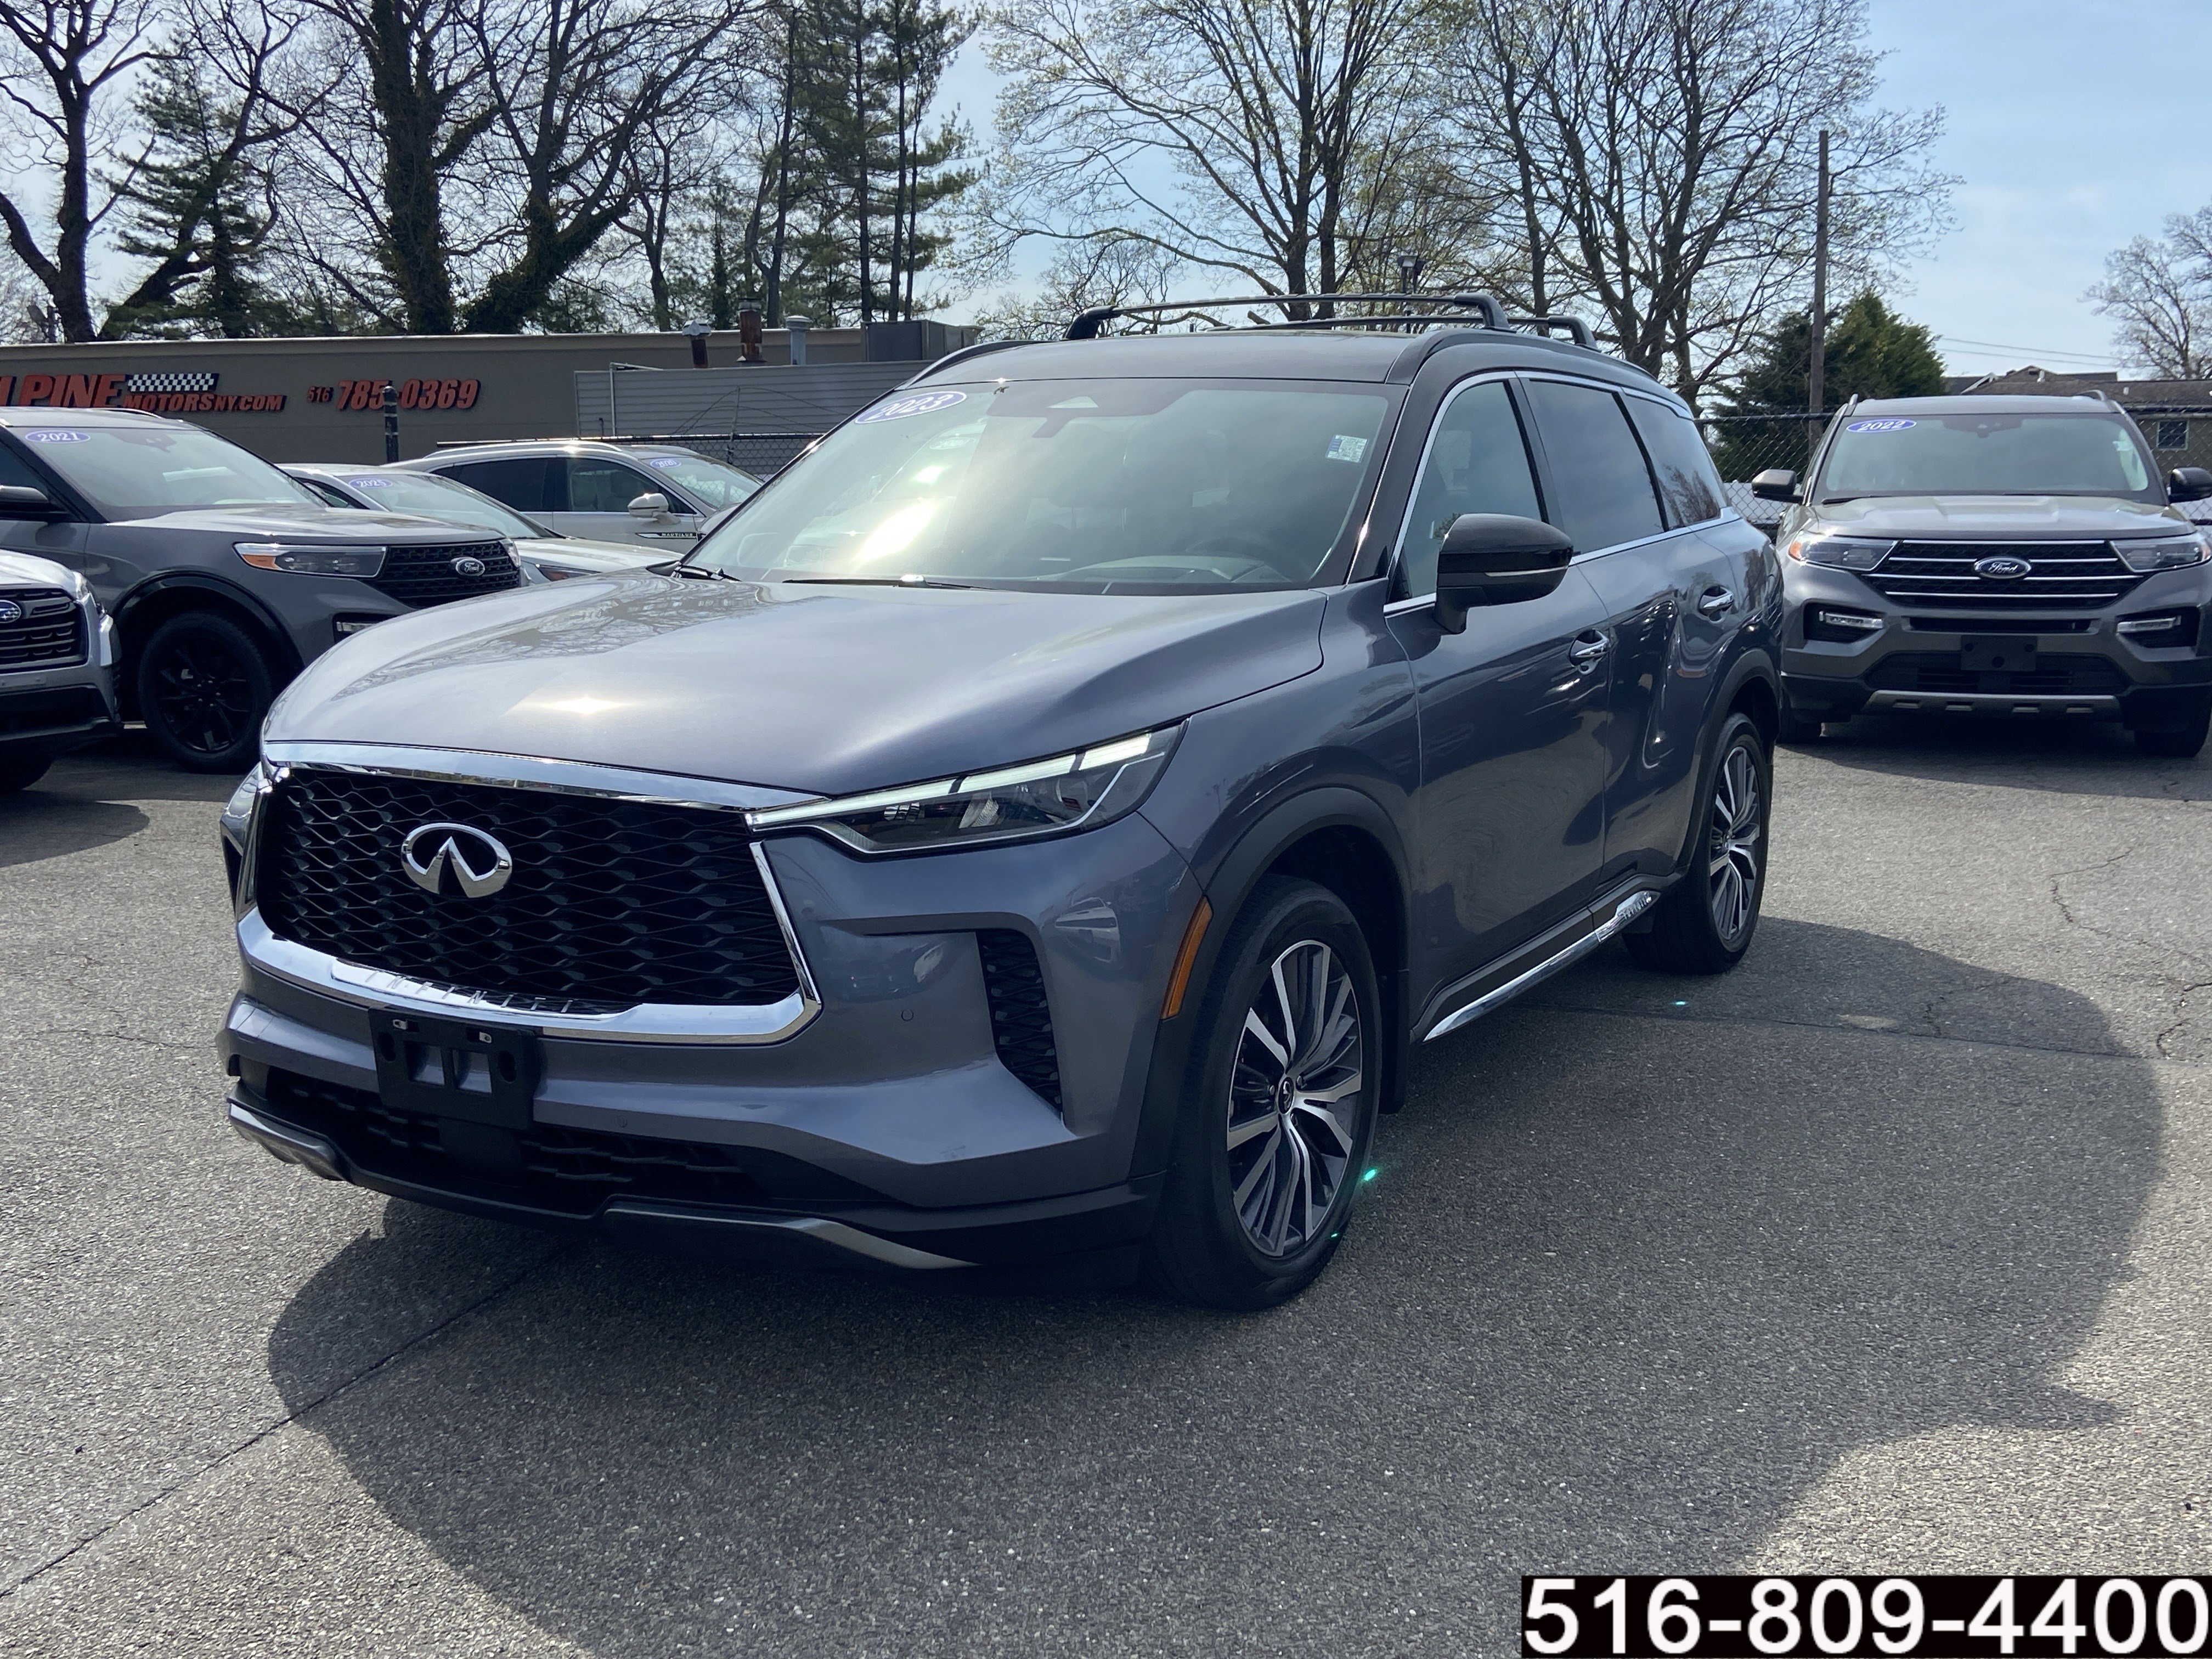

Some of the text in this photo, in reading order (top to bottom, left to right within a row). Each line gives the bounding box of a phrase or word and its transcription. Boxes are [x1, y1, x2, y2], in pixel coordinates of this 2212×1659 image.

[307, 379, 478, 410] 516 7850369
[863, 394, 955, 421] 2023
[1857, 421, 1906, 432] 2022
[37, 432, 80, 442] 2021
[464, 562, 479, 573] Ford
[1988, 561, 2018, 573] Ford
[364, 970, 574, 1013] INFINITI
